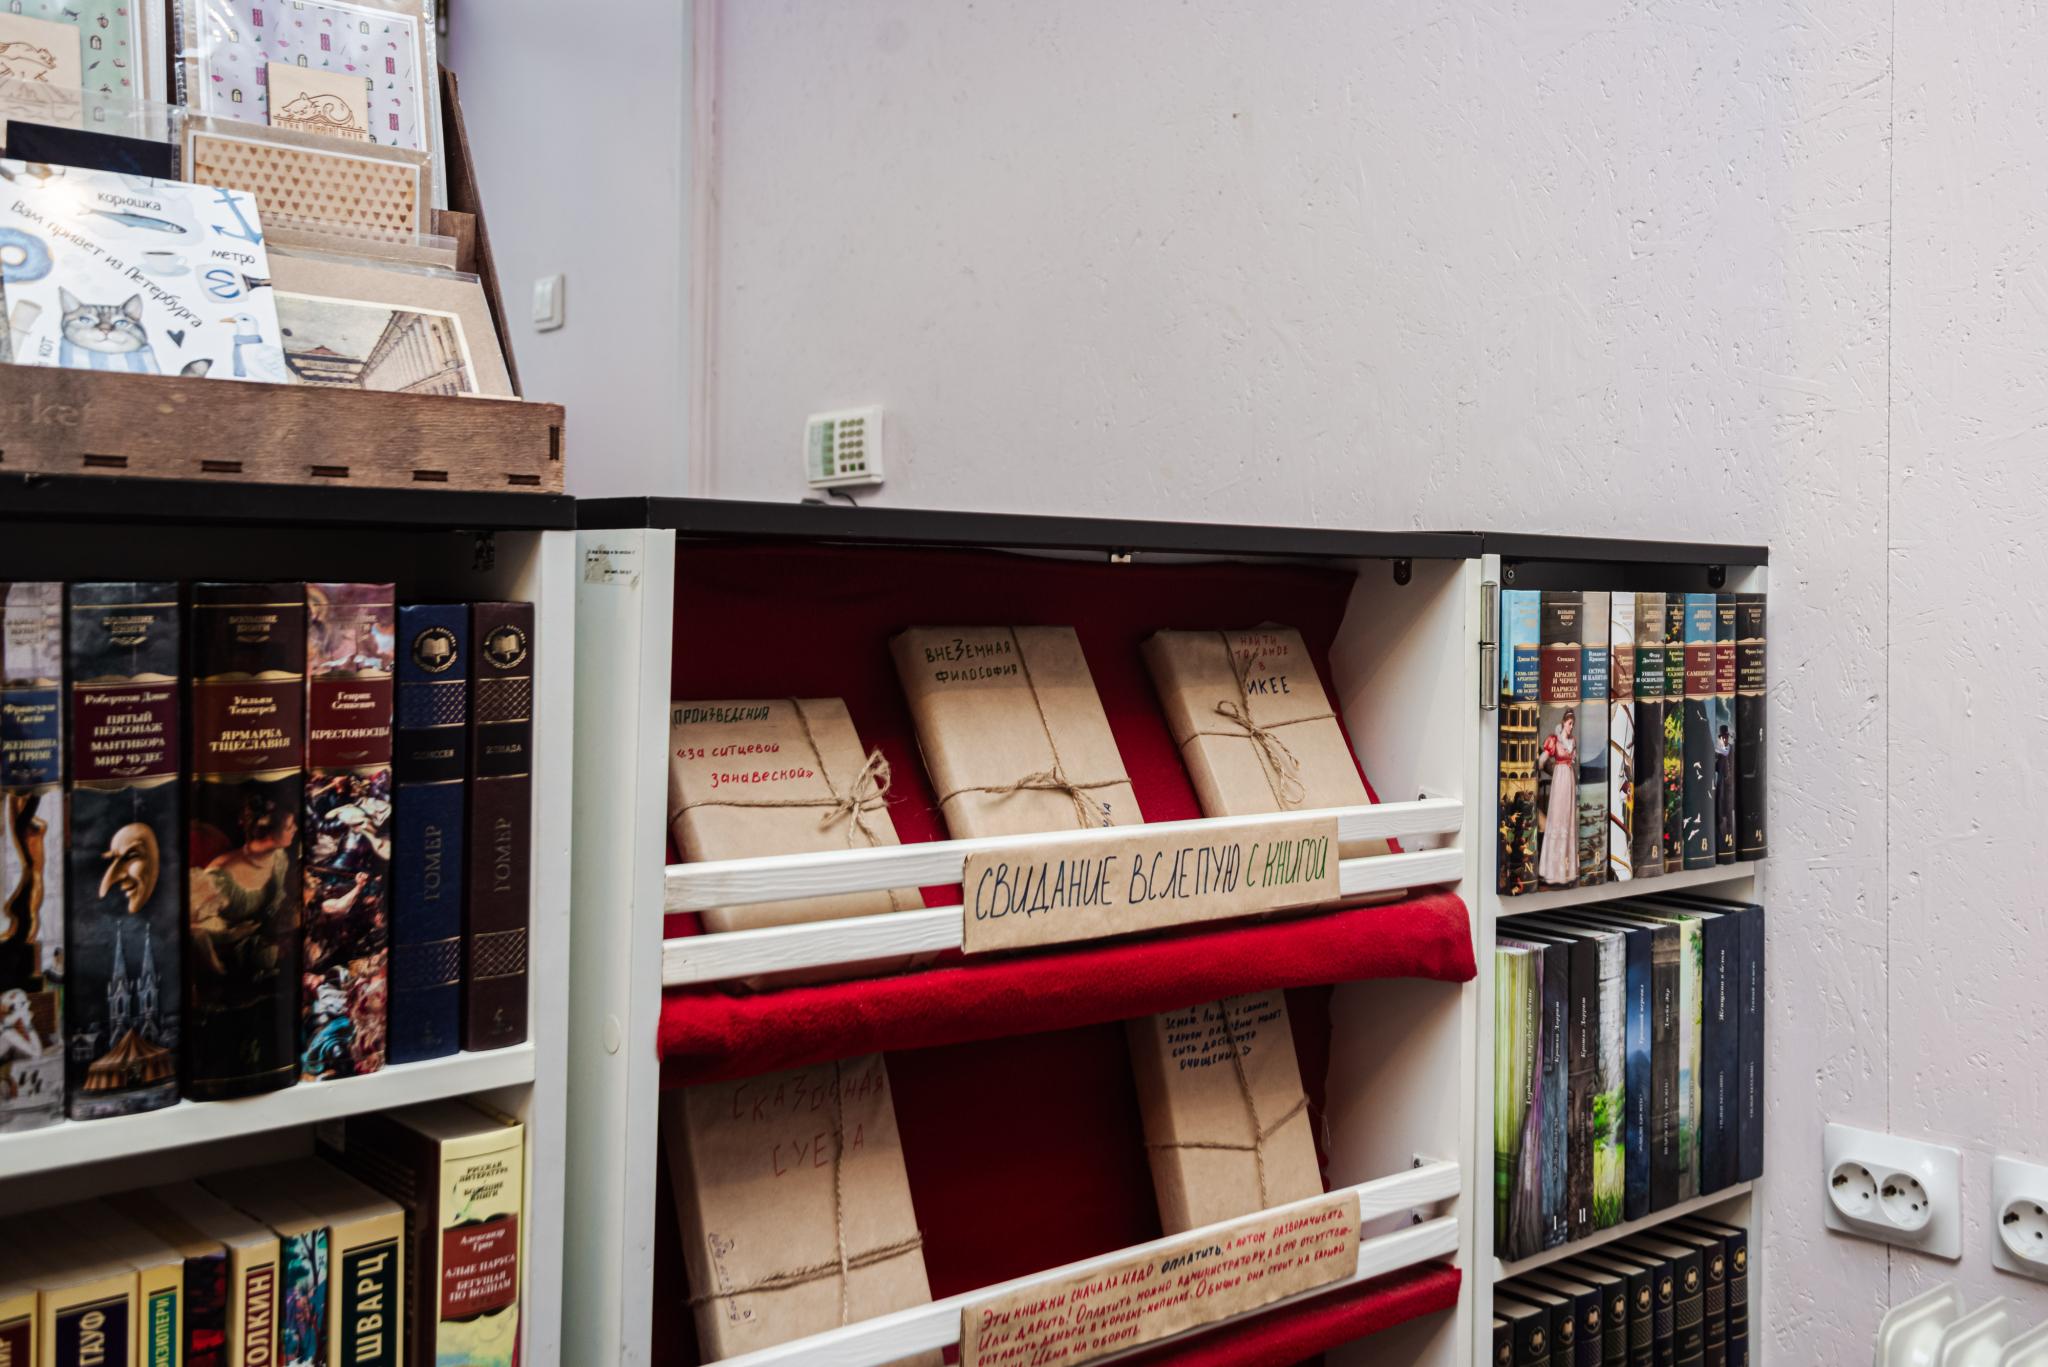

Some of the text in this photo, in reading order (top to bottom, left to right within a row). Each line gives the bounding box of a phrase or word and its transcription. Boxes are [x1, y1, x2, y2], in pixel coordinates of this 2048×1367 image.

[96, 190, 162, 211] корюшка
[10, 200, 203, 328] Вам привет из Петербурга
[211, 248, 256, 265] метро
[924, 638, 1012, 663] ВНЕЗЕМНАЯ
[935, 664, 1018, 683] ФИЛОСОФИЯ
[1246, 676, 1291, 695] ИКЕЕ
[106, 711, 153, 725] ПЯТЫЙ
[673, 705, 770, 728] ПРОИЗВЕДЕНИЯ
[94, 722, 163, 737] ПЕРСОНАЖ
[221, 727, 283, 741] ЯРМАРКА
[311, 726, 390, 740] КРЕСТОНОСЦЫ
[90, 737, 166, 753] МАНТИКОРА
[209, 737, 291, 753] ТЩЕСЛАВИЯ
[711, 742, 780, 758] ситцевой
[94, 751, 164, 768] МИР ЧУДЕС
[423, 824, 443, 902] ГОМЕР
[493, 816, 513, 894] ГОМЕР
[975, 835, 1330, 921] СВИДАНИЕ ВСЛЕПУЮ С КНИГОЙ
[445, 1253, 516, 1278] АЛЫЕ ПАРУСА
[1014, 1294, 1066, 1319] КНИЖКИ
[1070, 1276, 1118, 1304] СНАЧАЛА
[1121, 1263, 1155, 1286] НАДО
[1236, 1231, 1266, 1248] ПОТОМ
[449, 1278, 512, 1303] ПО ВОЛНАМ
[457, 1270, 507, 1291] БЕГУЩАЯ
[1137, 1280, 1172, 1302] МОЖНО
[355, 1251, 390, 1363] ШВАРЦ
[978, 1342, 1037, 1367] ОСТАВИТЬ
[1040, 1324, 1085, 1349] ДЕНЬГИ
[1090, 1322, 1096, 1332] В
[1247, 1268, 1264, 1283] ОНА
[1268, 1258, 1294, 1276] СТОИТ
[1297, 1254, 1311, 1267] НА
[246, 1273, 273, 1367] ОЛКИН
[79, 1309, 107, 1367] ГАУФ
[1073, 1340, 1087, 1354] НА
